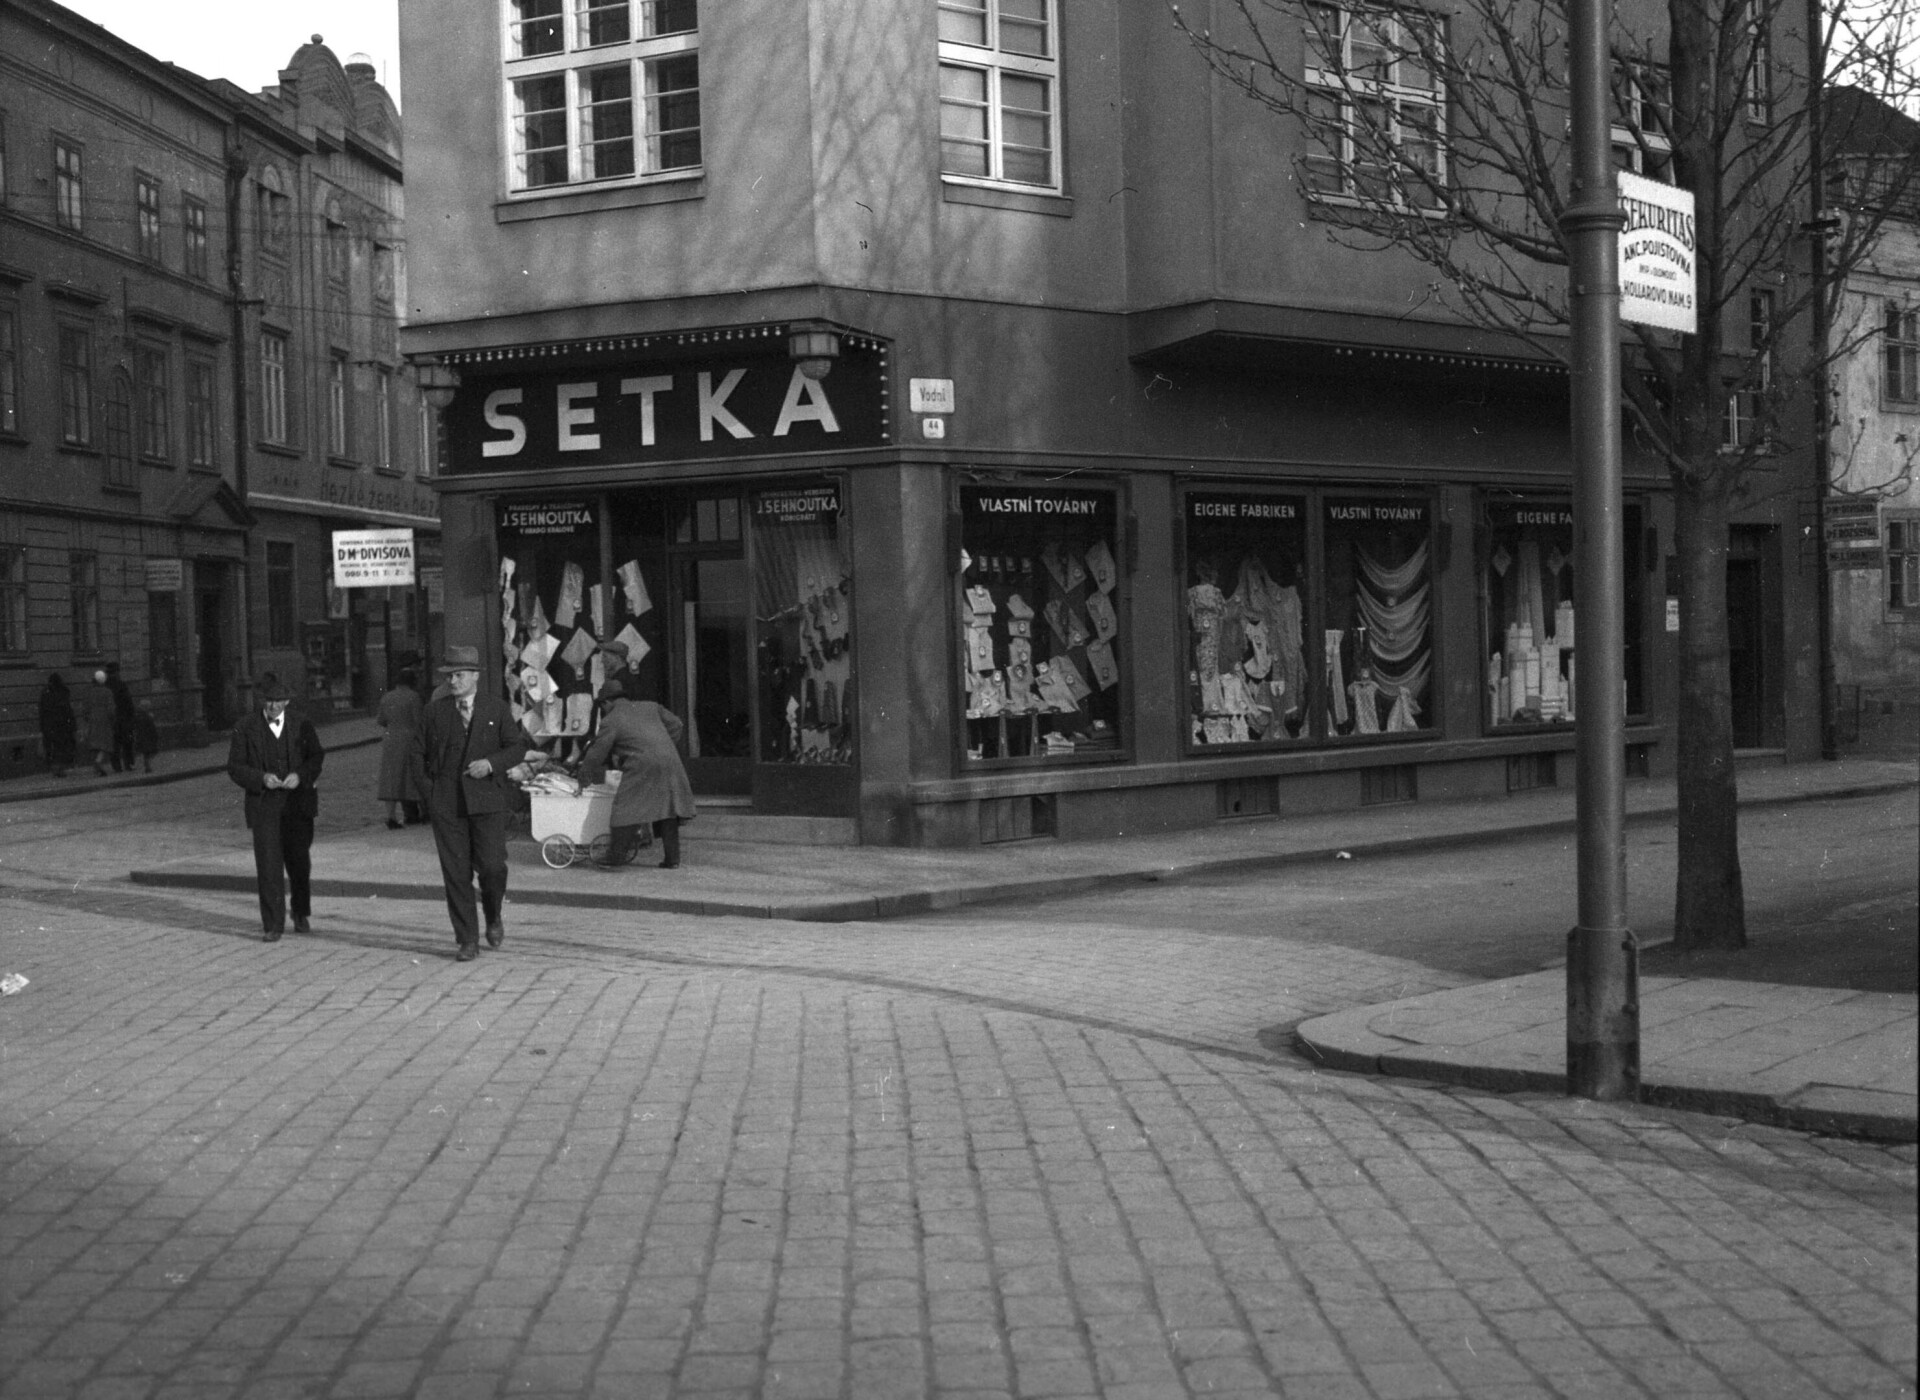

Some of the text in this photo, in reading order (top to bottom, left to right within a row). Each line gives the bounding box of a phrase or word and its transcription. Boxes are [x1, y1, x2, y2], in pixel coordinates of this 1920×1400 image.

[1620, 196, 1694, 252] SEKURITAS
[482, 364, 840, 458] SETKA
[929, 420, 939, 429] 44
[511, 510, 593, 527] SEHNOUTKA
[1194, 503, 1296, 519] EIGENE FABRIKEN
[1516, 511, 1557, 525] EIGENE
